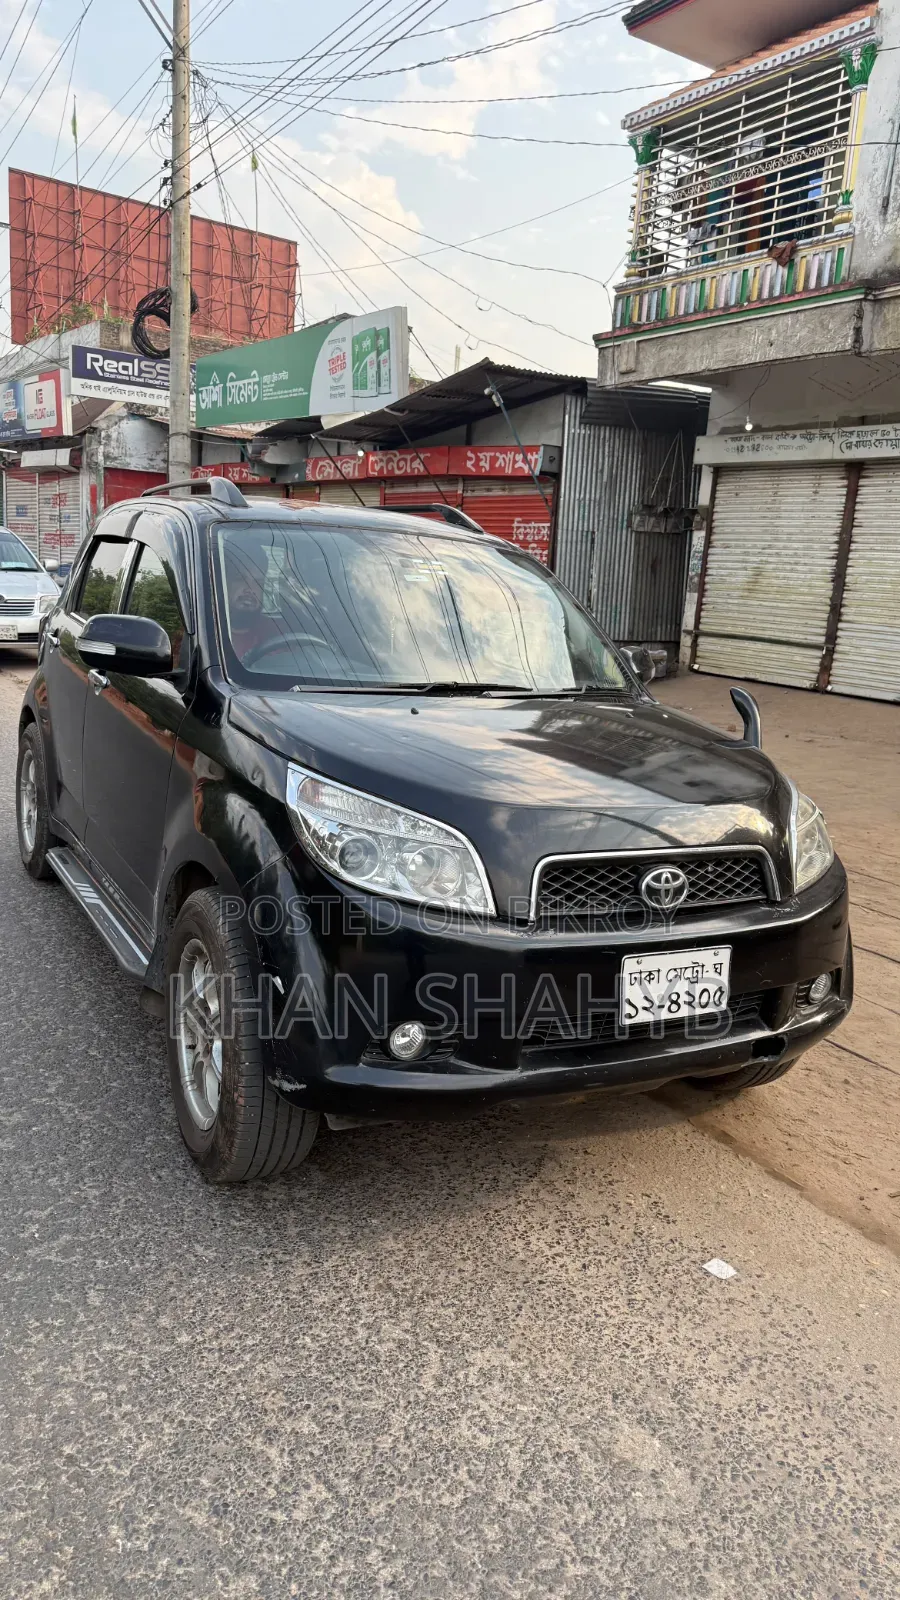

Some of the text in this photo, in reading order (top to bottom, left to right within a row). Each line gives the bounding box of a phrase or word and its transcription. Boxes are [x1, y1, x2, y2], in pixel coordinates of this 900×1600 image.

[328, 351, 346, 367] TRIPLE
[328, 361, 346, 376] TESTED
[226, 370, 259, 405] সিমেন্ট
[368, 451, 430, 476] সেন্টার
[628, 969, 661, 986] ঢাকা
[624, 986, 725, 1019] ১২-৪২০৫
